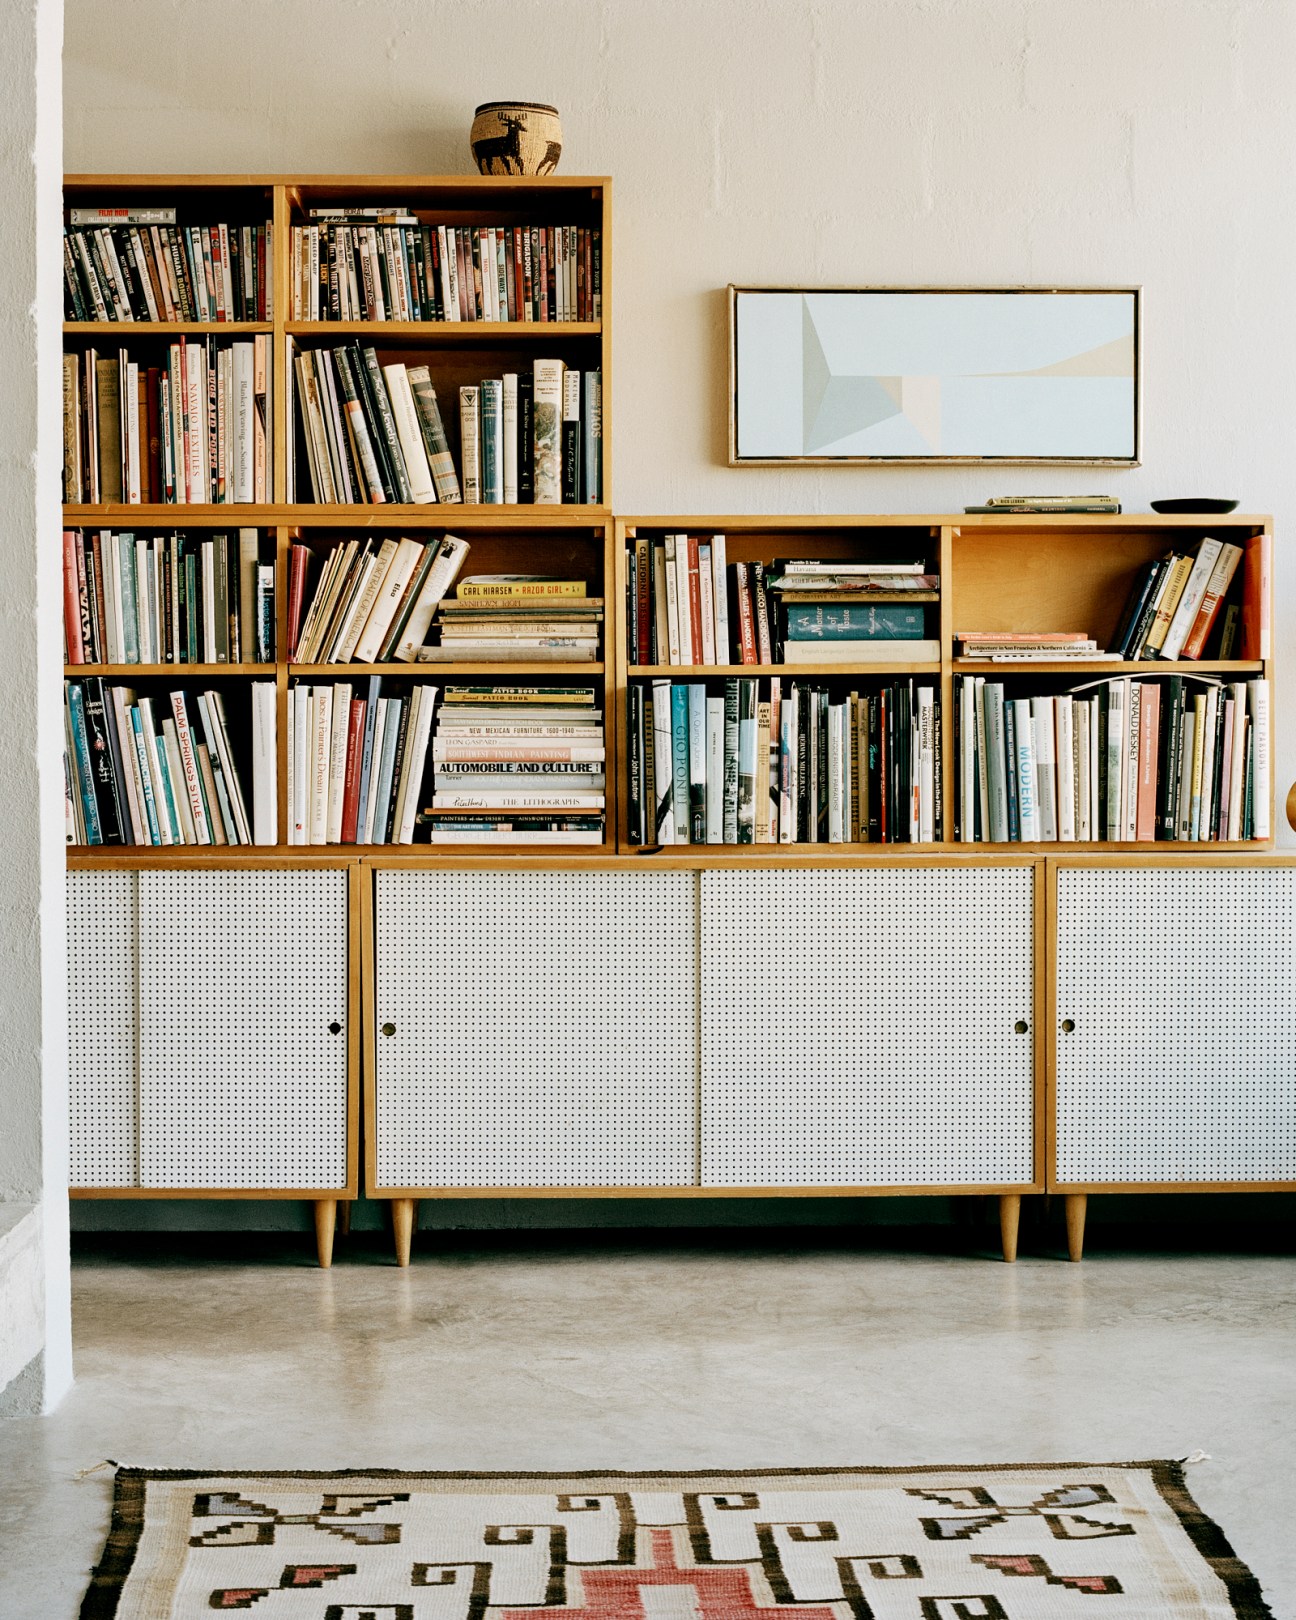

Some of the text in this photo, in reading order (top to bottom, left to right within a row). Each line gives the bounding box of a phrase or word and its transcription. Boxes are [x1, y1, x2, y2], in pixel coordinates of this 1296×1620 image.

[172, 245, 190, 315] HUMAN BONDAGE
[523, 233, 531, 277] BRIGADOON
[189, 383, 200, 477] NAVAJO TEXTILES
[382, 412, 399, 445] Jewelry
[591, 409, 601, 437] TAOS
[464, 587, 480, 595] CARL
[522, 586, 544, 594] RAZOR
[693, 720, 701, 746] Quincy
[1130, 689, 1139, 761] DONALD DESKEY
[138, 748, 151, 801] CONCRETE
[174, 697, 202, 819] PALM SPRINGS STYLE
[440, 763, 592, 772] AUTOMOBILE AND CULTURE
[676, 725, 687, 805] GIO PONTI
[1019, 746, 1032, 818] MODERN
